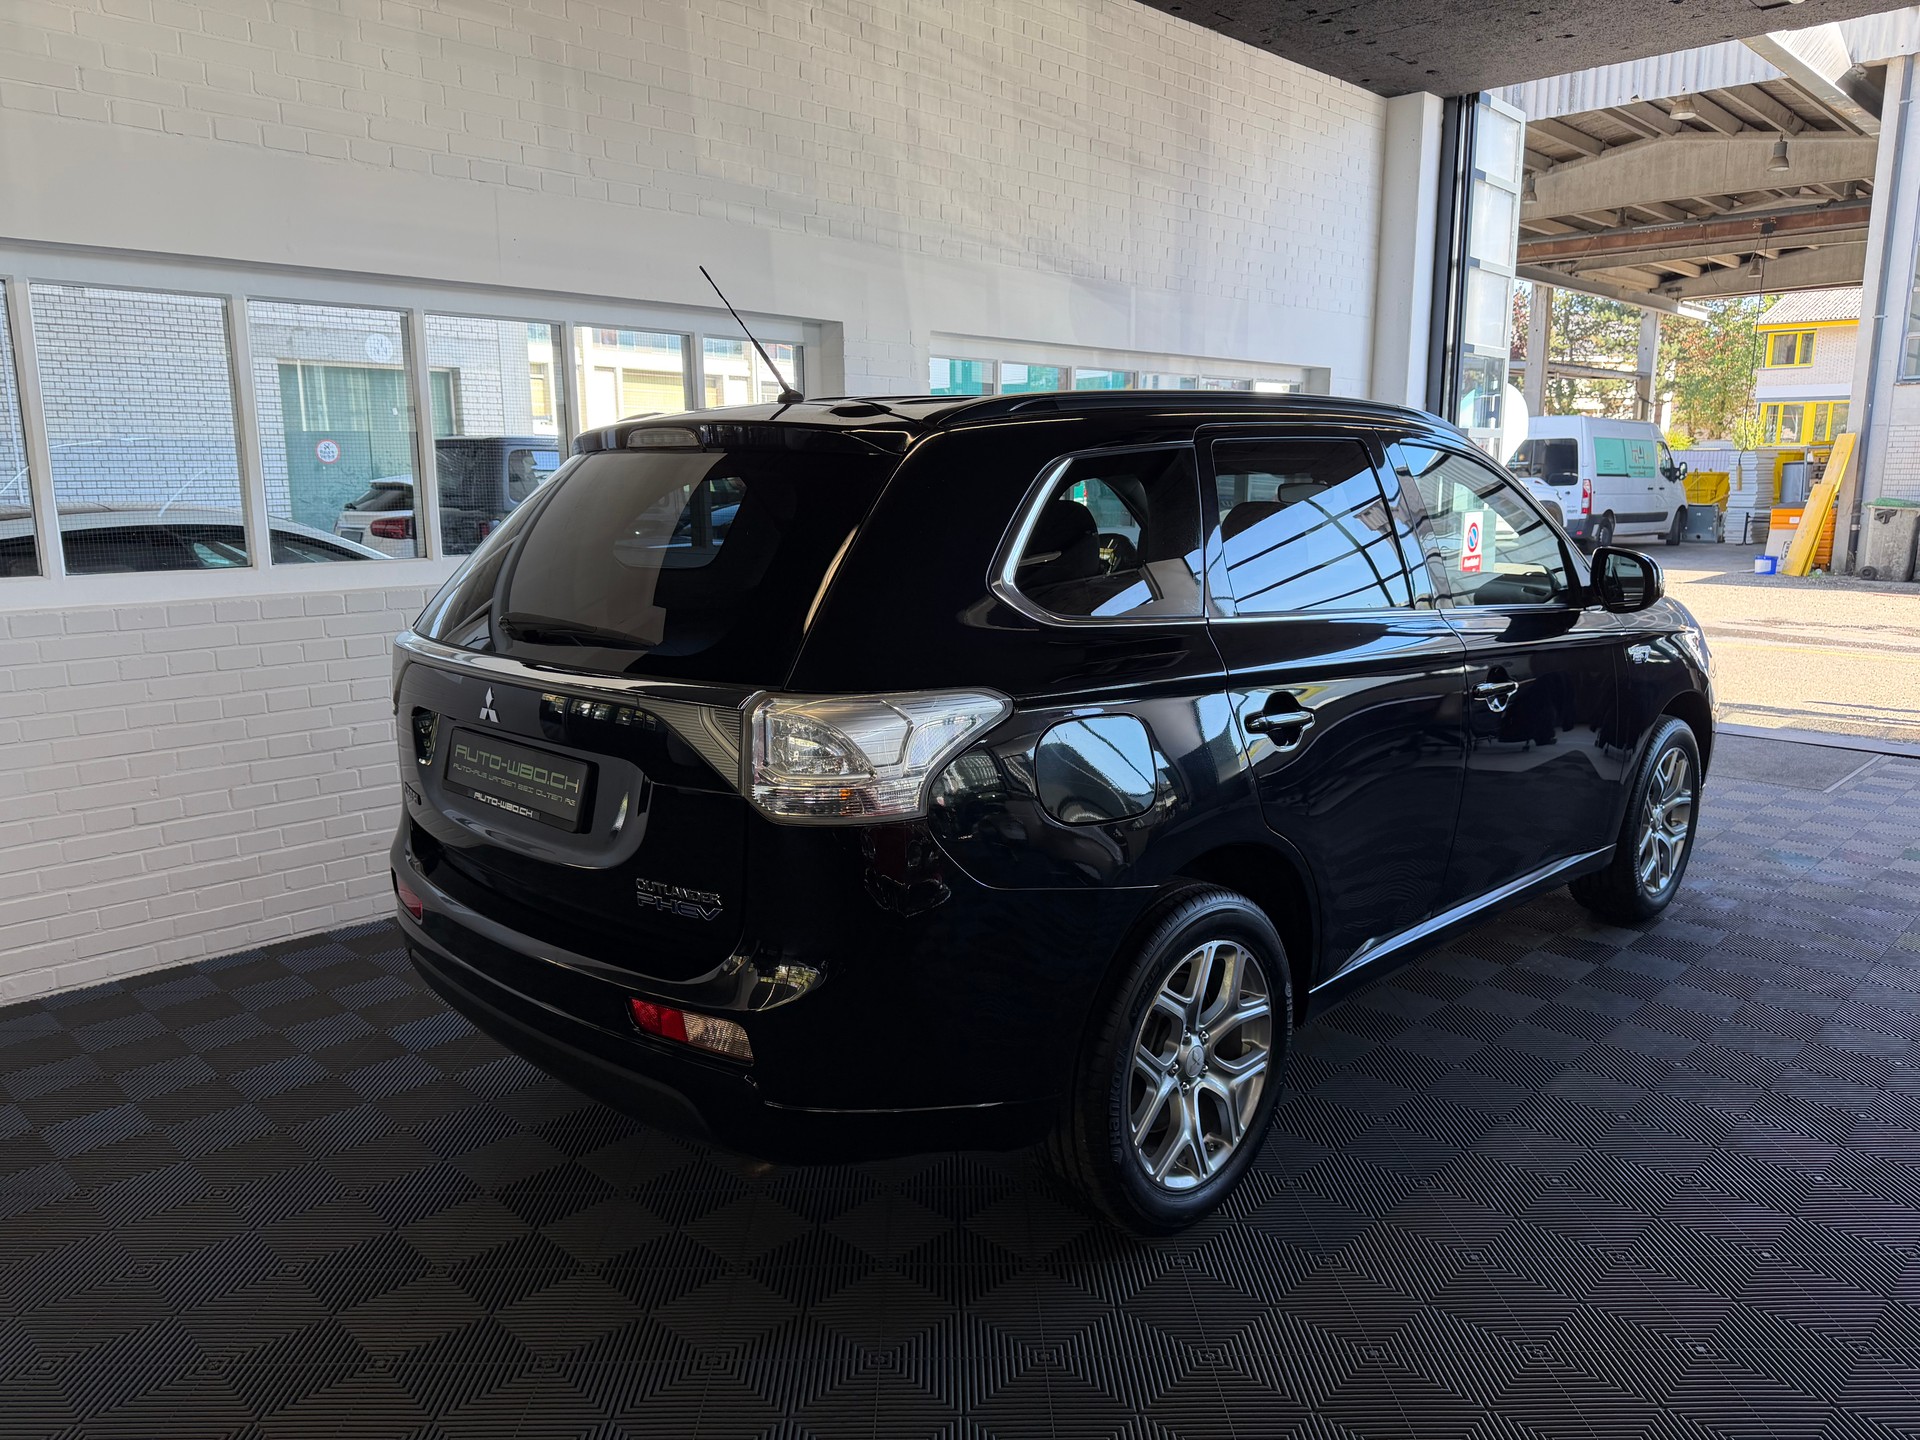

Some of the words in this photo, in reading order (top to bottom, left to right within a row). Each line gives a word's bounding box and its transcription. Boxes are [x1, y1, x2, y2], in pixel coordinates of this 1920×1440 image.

[536, 789, 563, 803] OLTEN
[636, 878, 722, 906] OUTLANDER
[636, 891, 723, 921] PHEV
